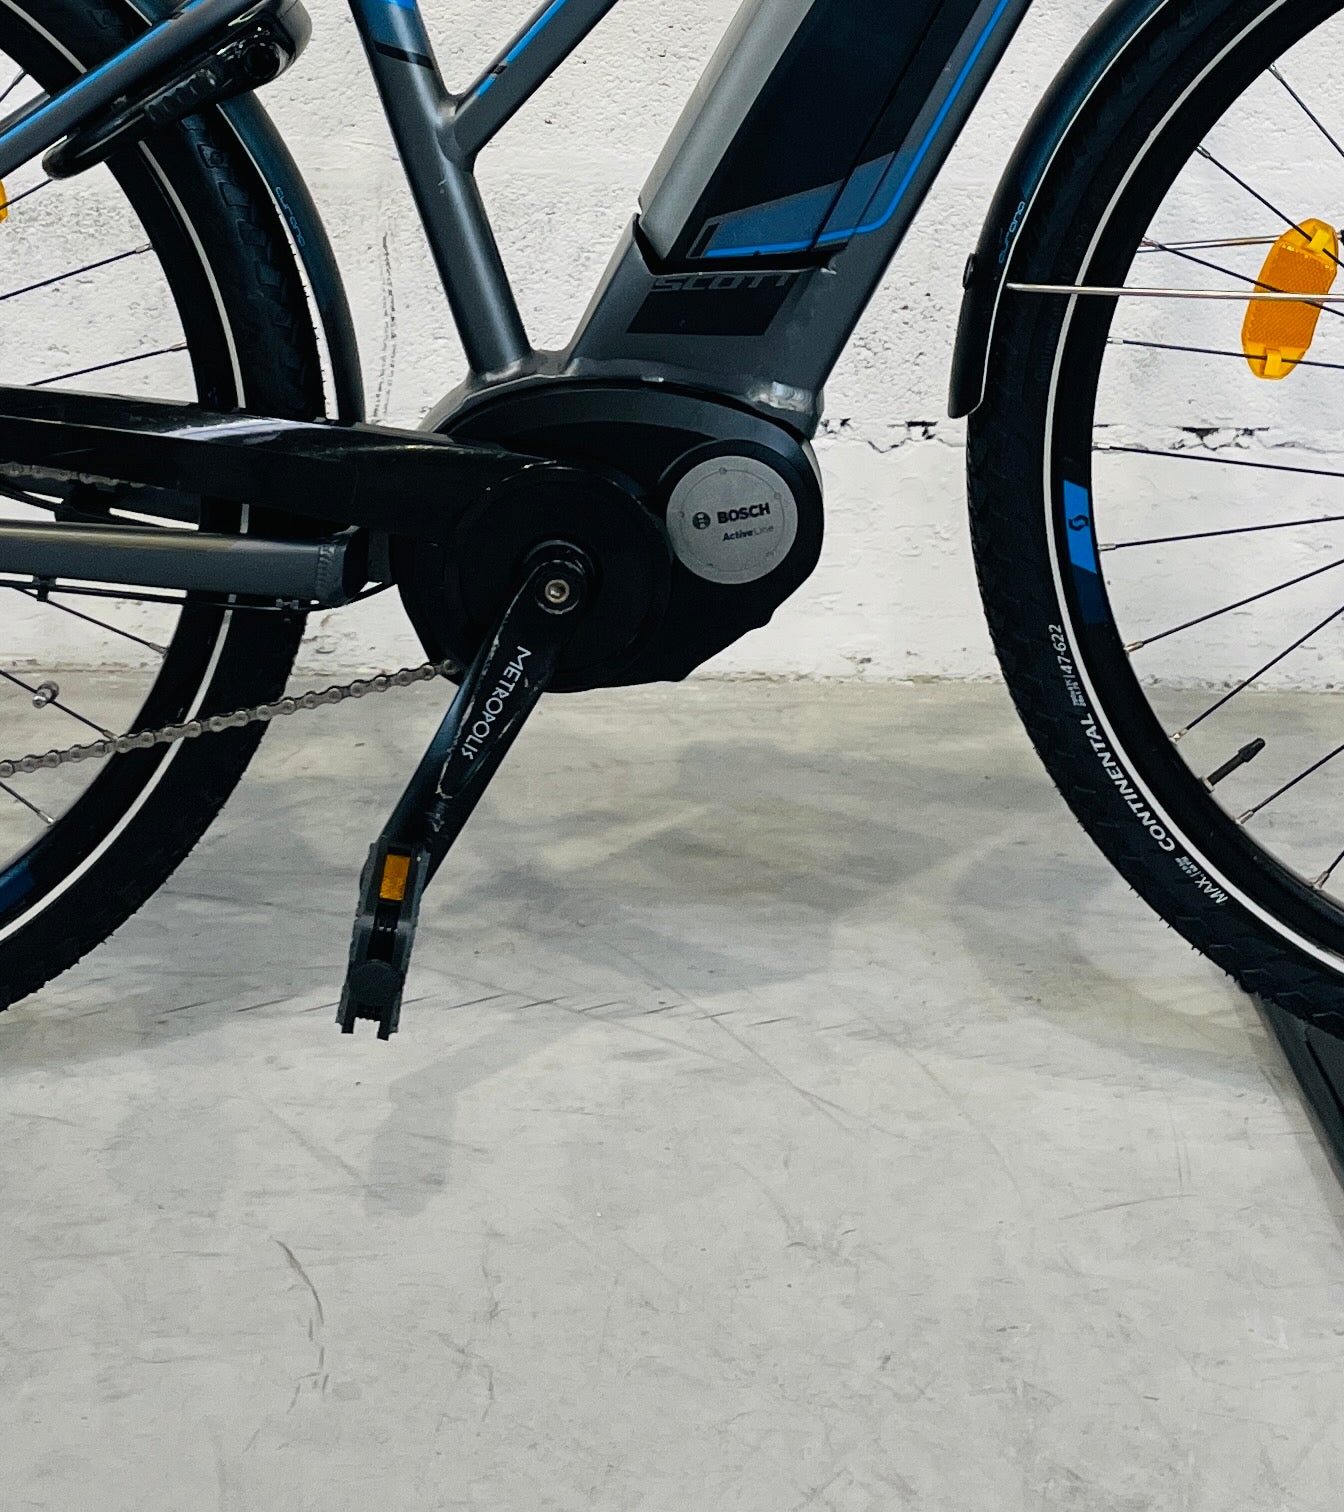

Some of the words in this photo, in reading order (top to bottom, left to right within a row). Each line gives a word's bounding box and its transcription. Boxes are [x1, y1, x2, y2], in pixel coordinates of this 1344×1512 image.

[717, 502, 771, 524] BOSCH
[1048, 624, 1074, 676] 47-622
[460, 645, 534, 761] METROPOLIS
[1080, 713, 1176, 853] CONTINENTAL
